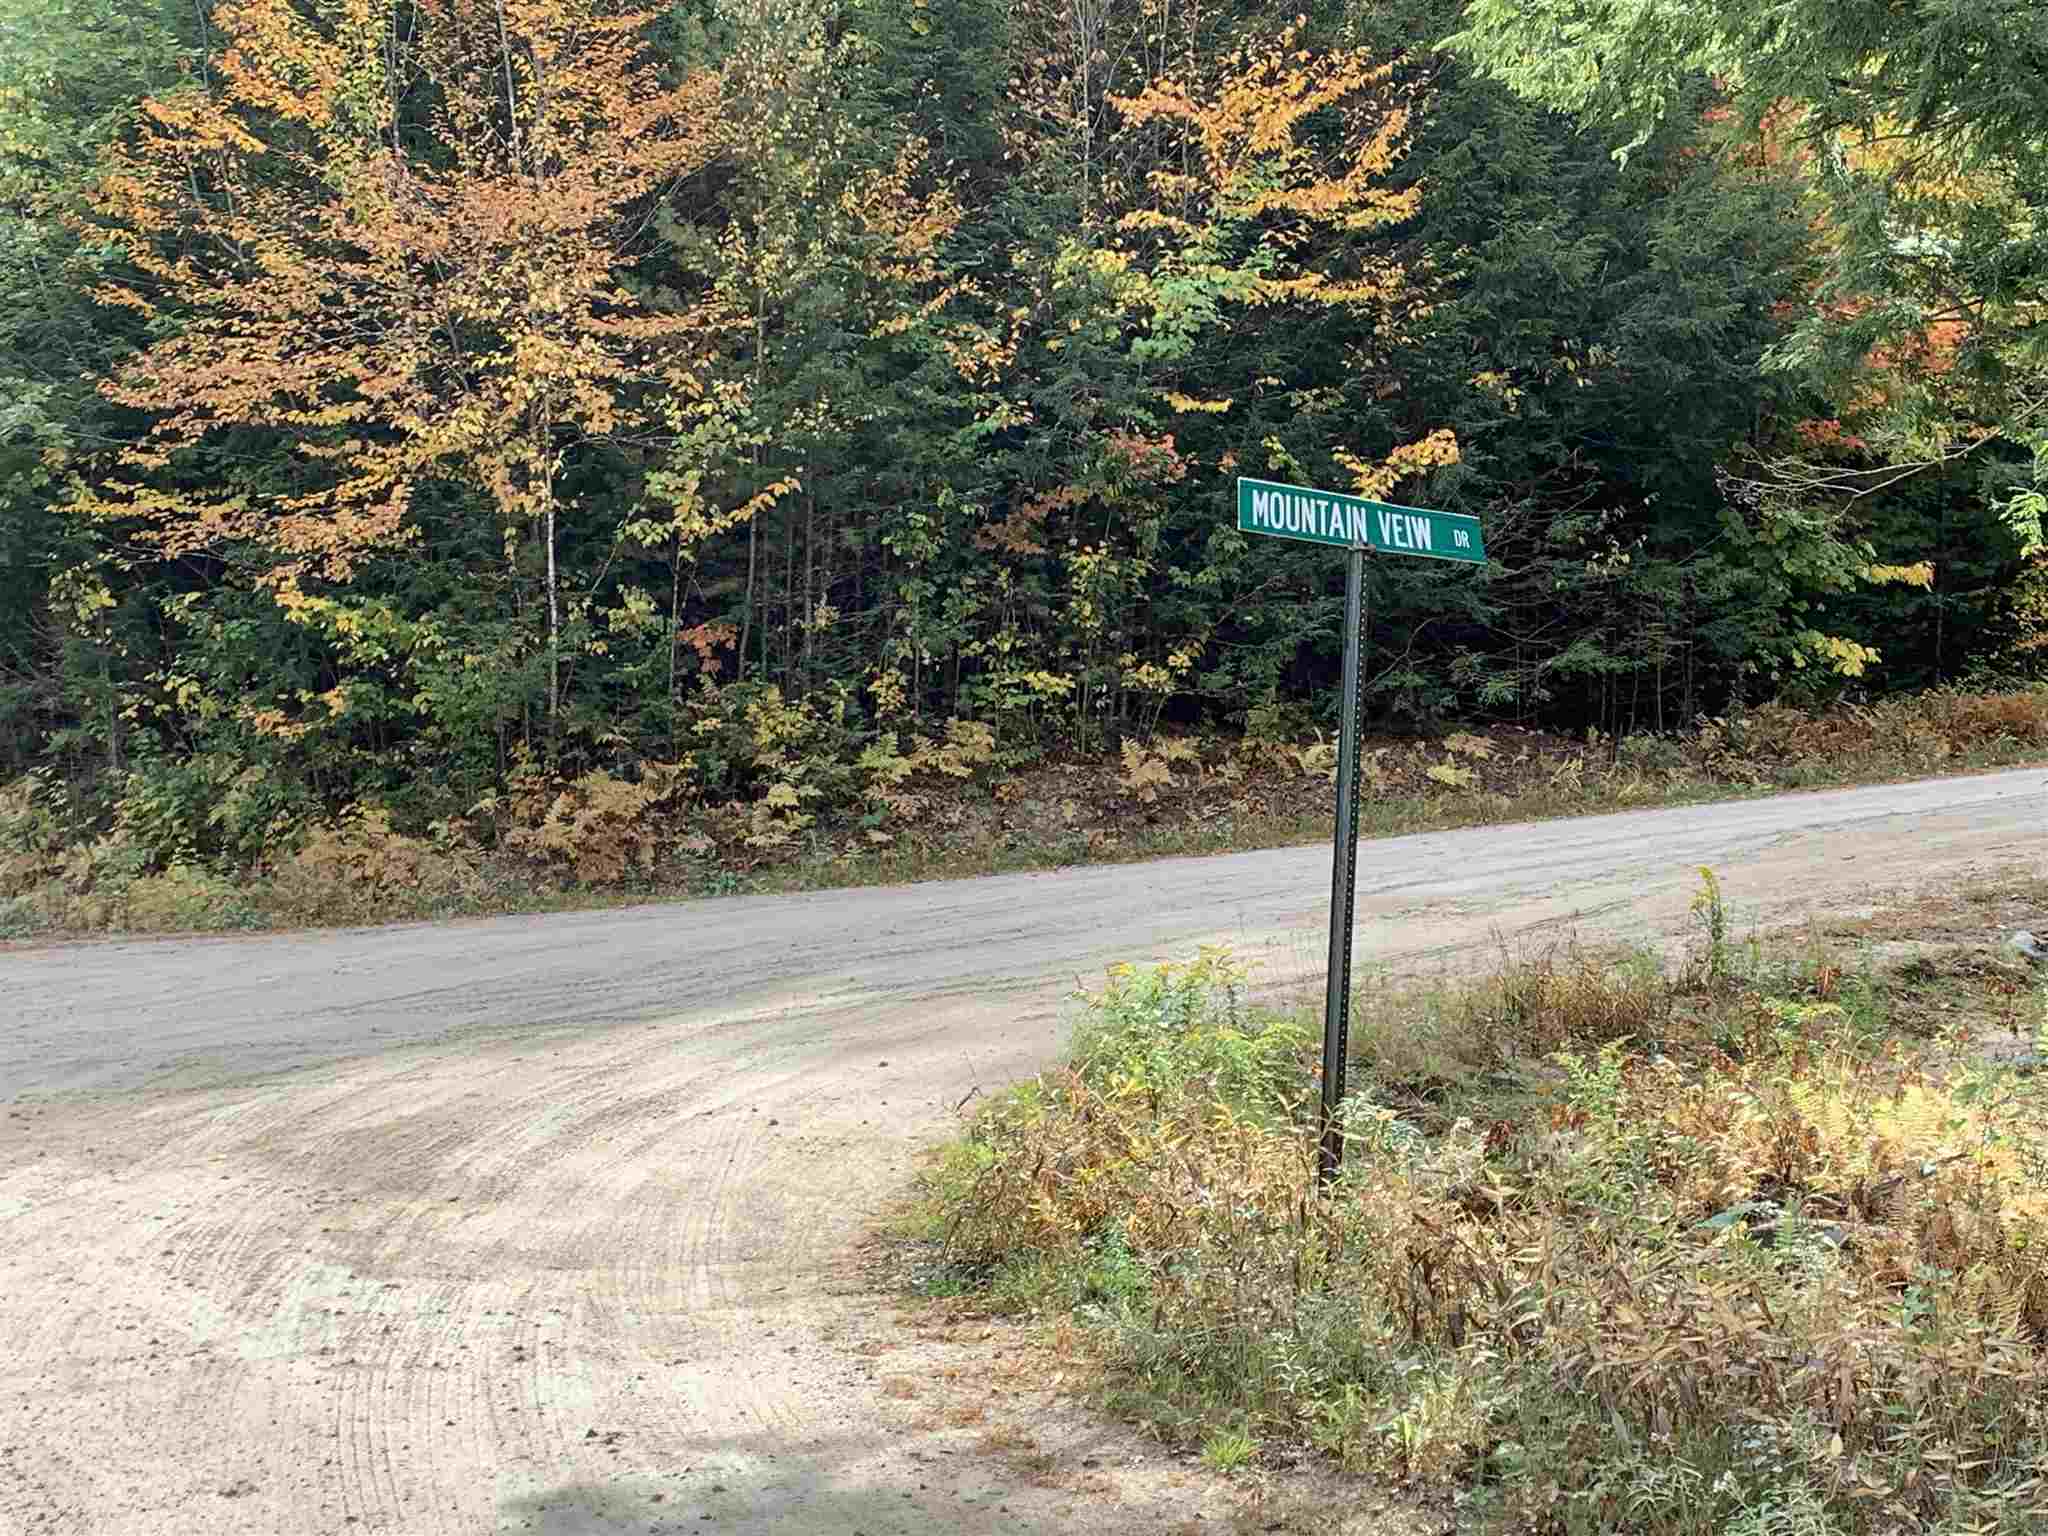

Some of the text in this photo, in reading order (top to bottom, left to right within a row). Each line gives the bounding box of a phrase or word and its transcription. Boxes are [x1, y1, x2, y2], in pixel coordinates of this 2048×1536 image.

[1252, 489, 1471, 550] MOUNTAIN VEIW DR
